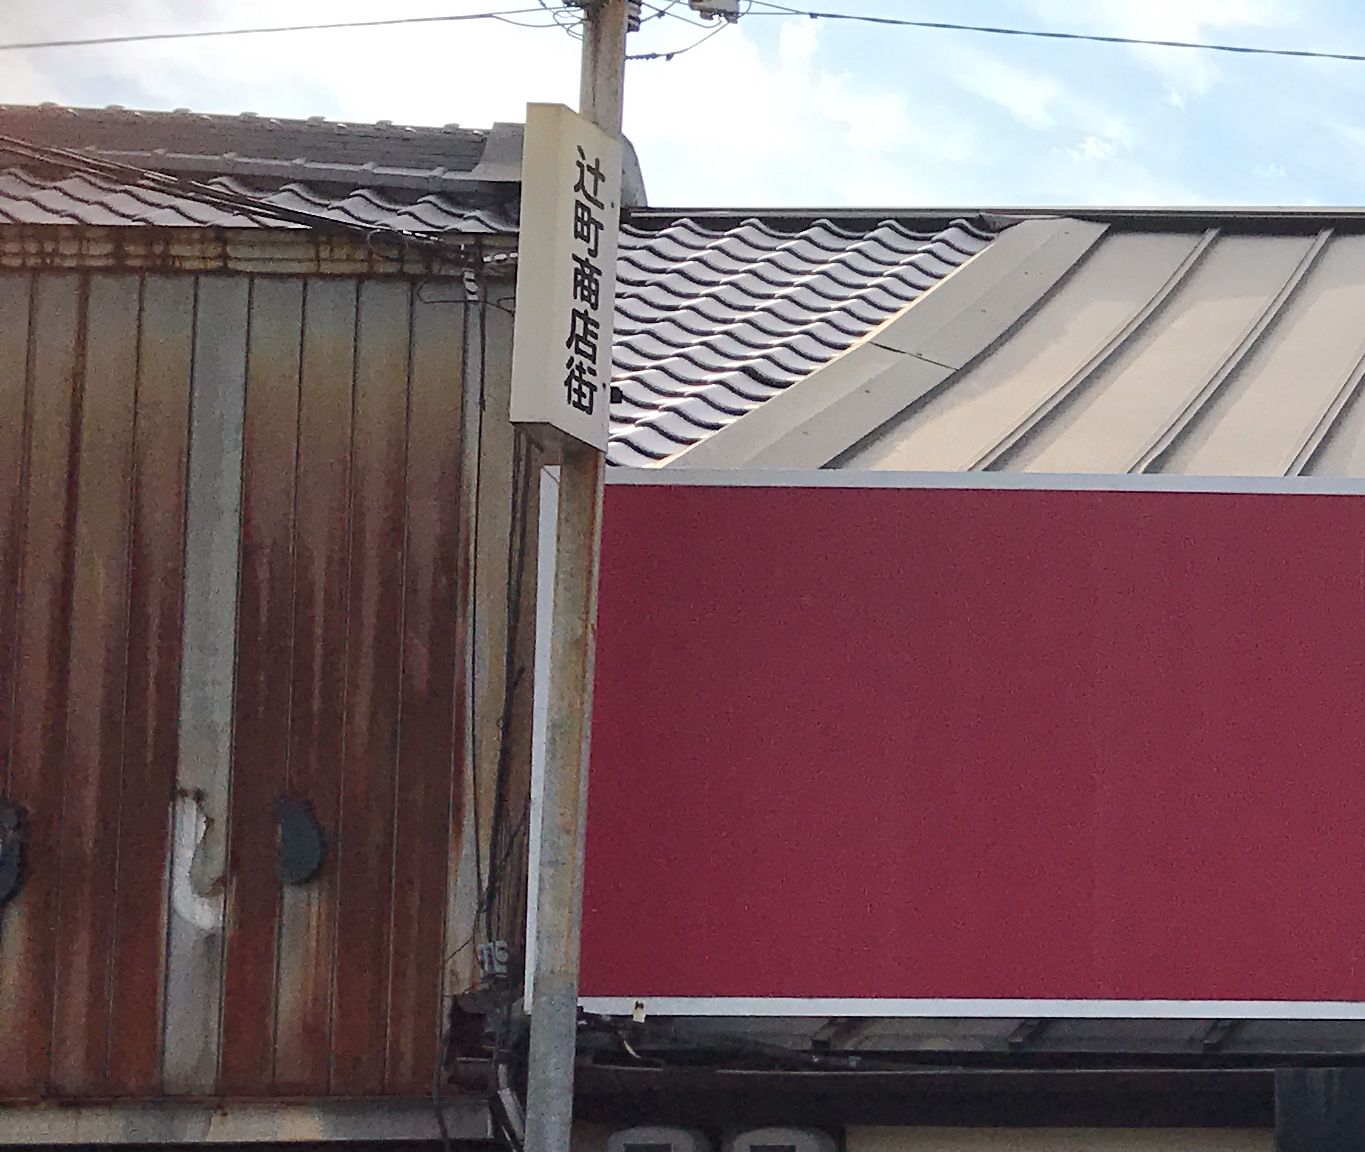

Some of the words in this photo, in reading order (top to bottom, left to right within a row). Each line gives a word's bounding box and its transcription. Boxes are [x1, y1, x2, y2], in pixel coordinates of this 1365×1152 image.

[563, 144, 606, 416] 辻町商店街
